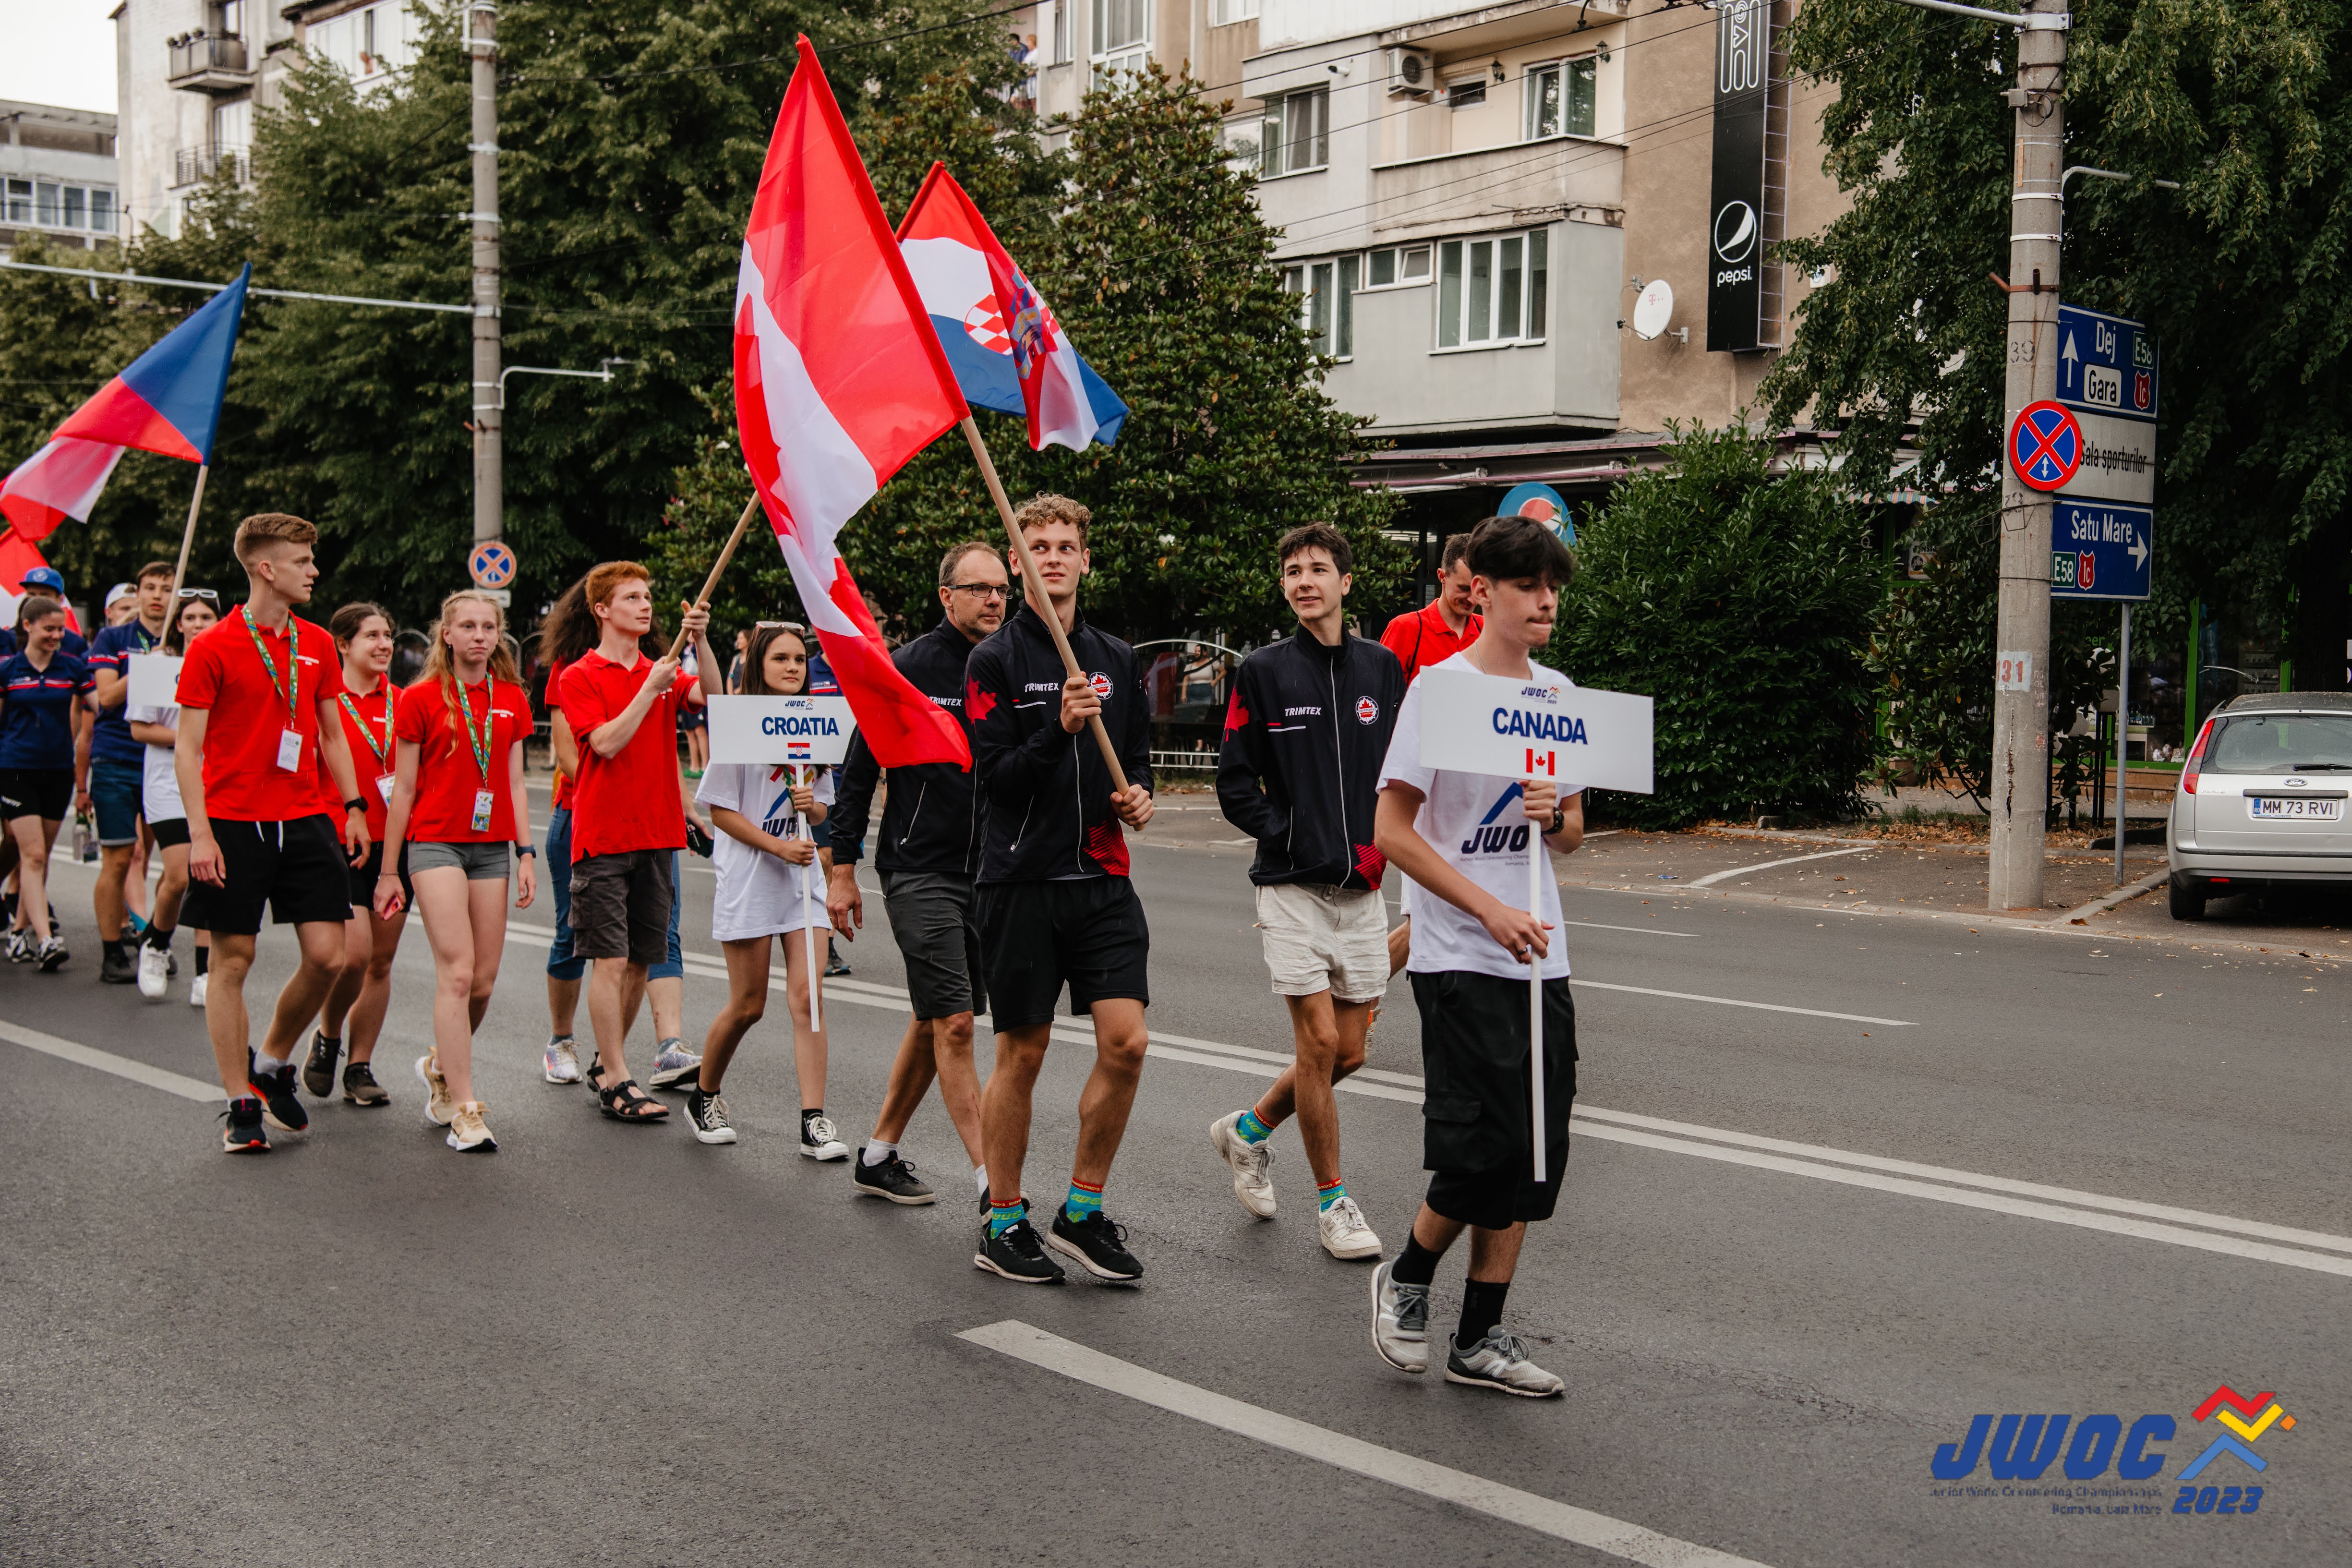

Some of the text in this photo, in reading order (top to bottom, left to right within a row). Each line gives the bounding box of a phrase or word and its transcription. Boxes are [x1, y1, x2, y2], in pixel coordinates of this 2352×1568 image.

[1717, 266, 1750, 287] pepsi
[2096, 321, 2116, 363] Dej
[2135, 338, 2153, 365] E58
[2088, 369, 2117, 404] Gara
[2138, 378, 2147, 404] 1c
[2080, 439, 2147, 476] Sala sporturilor
[2072, 510, 2133, 544] Satu Mare
[2054, 557, 2074, 583] E58
[2083, 561, 2091, 584] 1c
[1025, 682, 1060, 693] TRIMTEX
[1521, 687, 1547, 698] JWOC
[929, 696, 962, 707] TRIMTEX
[1285, 706, 1322, 717] TRIMTEX
[762, 716, 840, 736] CROATIA
[1493, 707, 1588, 745] CANADA
[2263, 800, 2332, 815] MM 73 RVI
[1461, 825, 1530, 854] JWO
